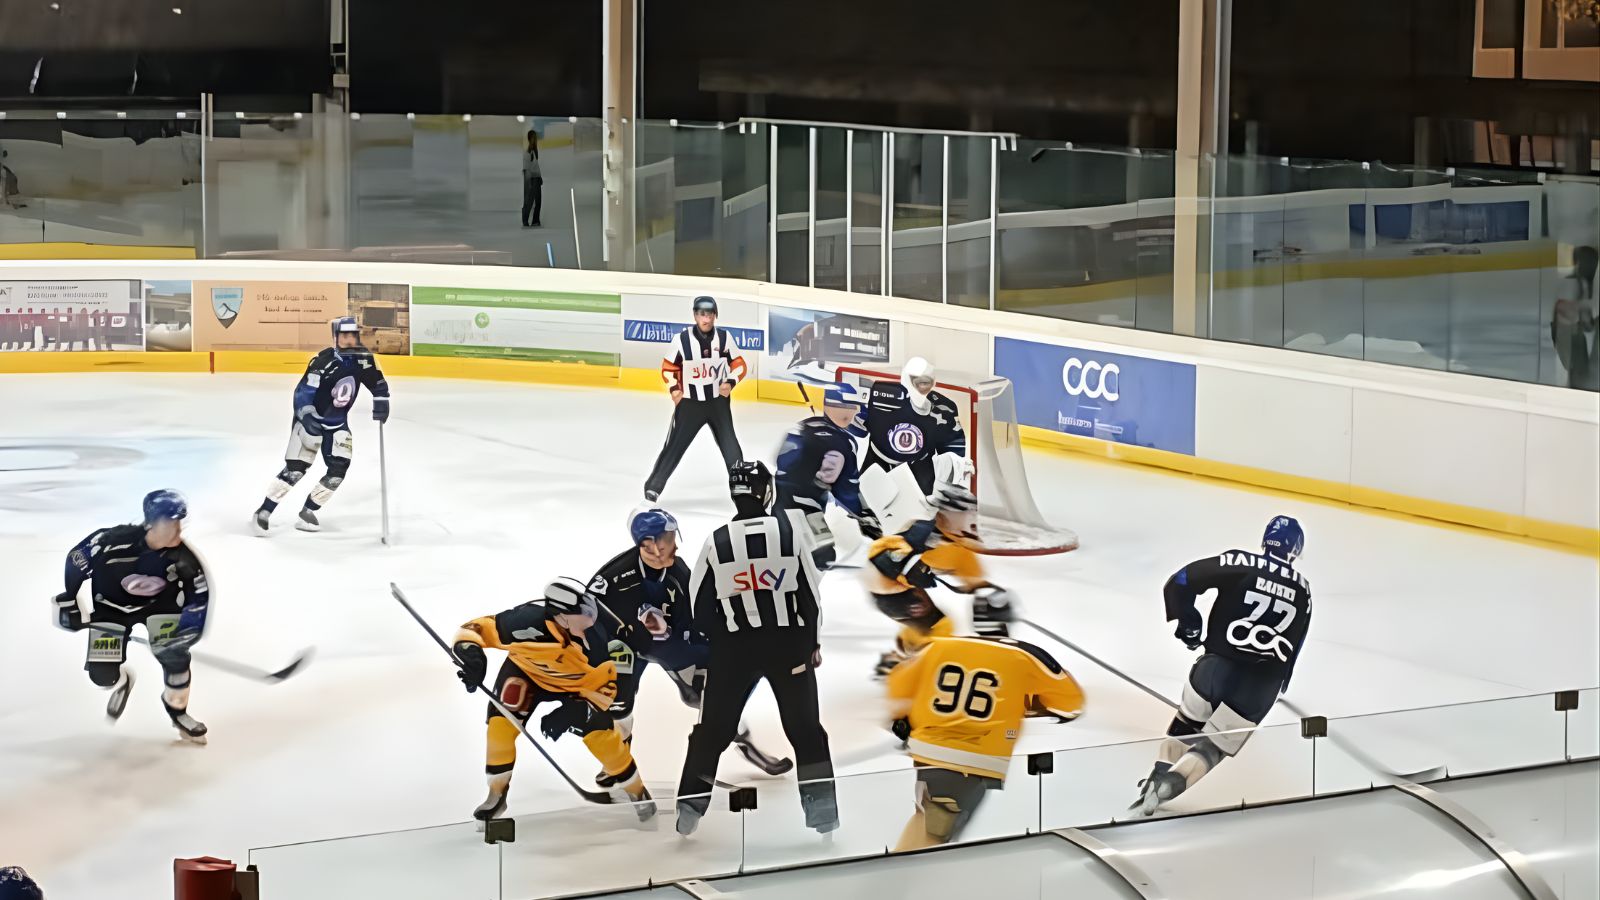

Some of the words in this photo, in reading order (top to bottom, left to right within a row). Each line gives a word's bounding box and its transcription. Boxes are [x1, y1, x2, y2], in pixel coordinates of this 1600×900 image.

[1062, 357, 1120, 402] CCC
[733, 563, 787, 592] sky
[1243, 590, 1297, 634] 77
[932, 664, 999, 719] 96
